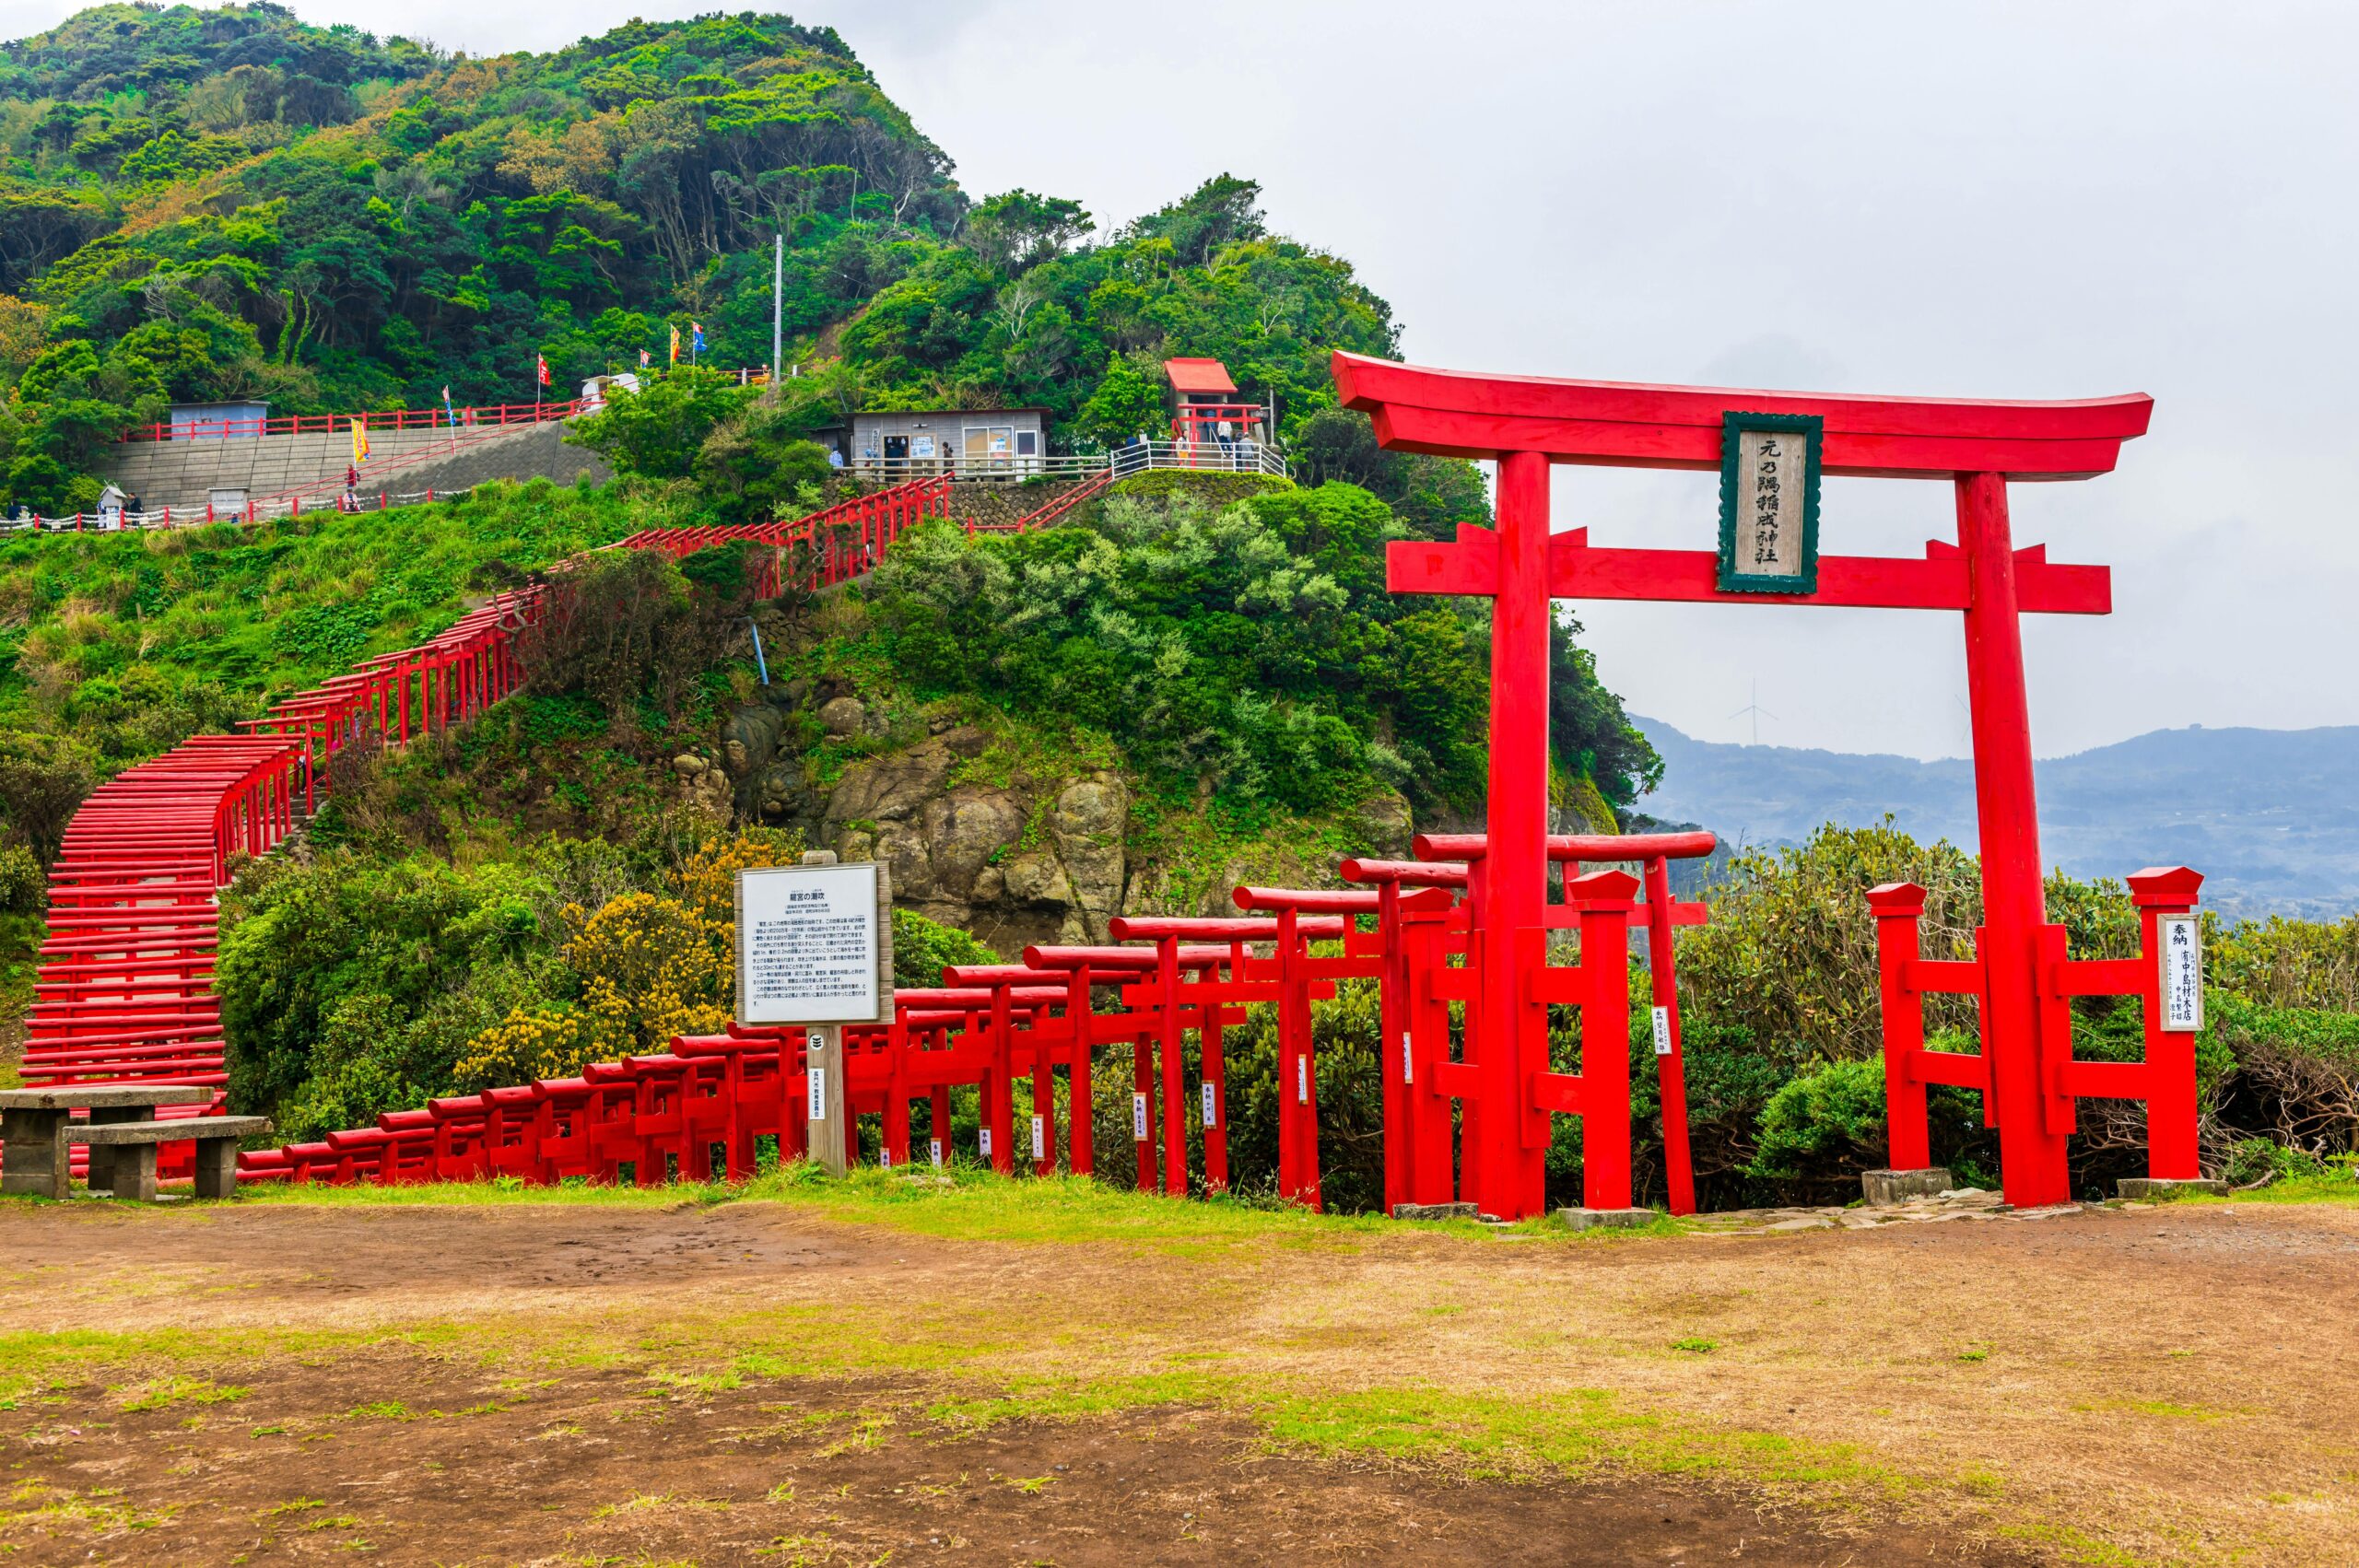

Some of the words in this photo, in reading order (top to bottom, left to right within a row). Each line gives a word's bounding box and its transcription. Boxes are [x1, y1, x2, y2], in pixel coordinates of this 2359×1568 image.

[1755, 440, 1781, 564] 元乃隅稲成神社
[2173, 924, 2188, 945] 奉納
